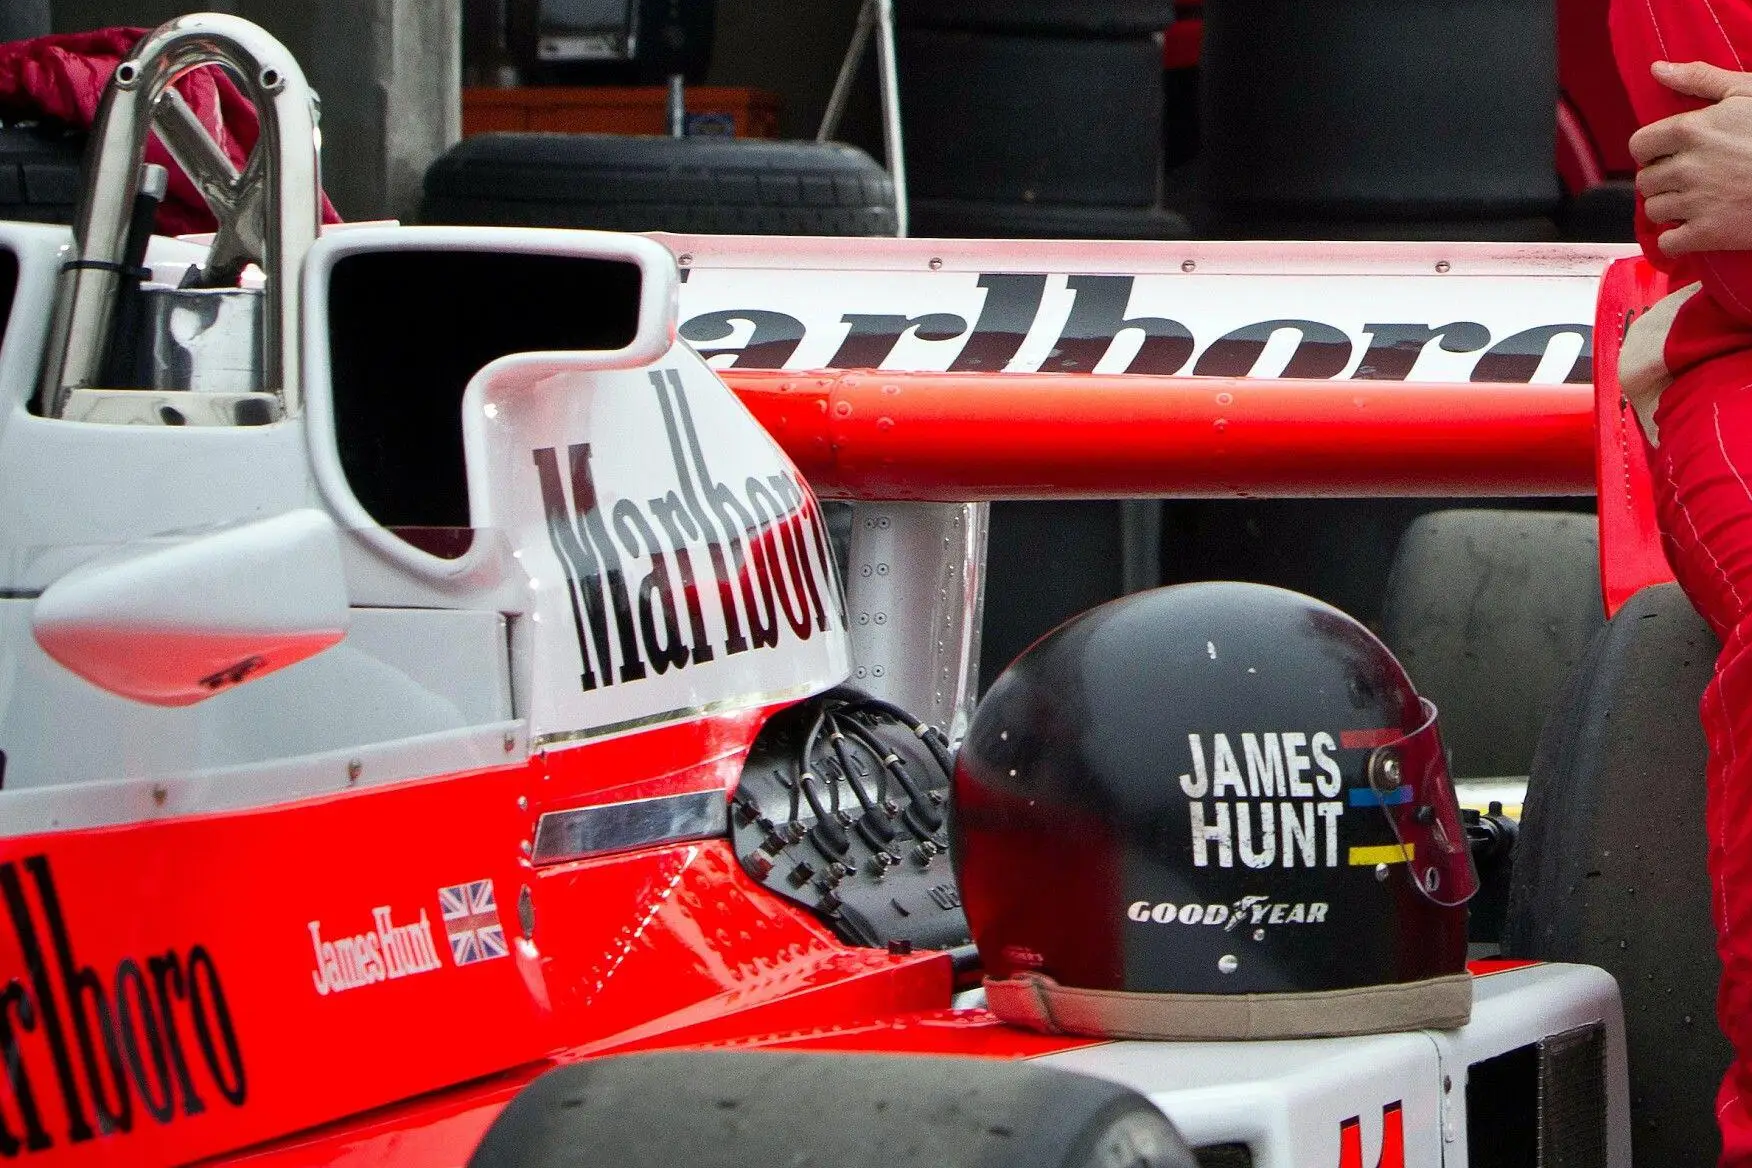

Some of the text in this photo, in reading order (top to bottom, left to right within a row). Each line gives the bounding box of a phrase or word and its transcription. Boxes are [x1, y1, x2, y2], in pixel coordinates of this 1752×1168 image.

[679, 272, 1593, 383] arlboro
[533, 369, 848, 692] Marlbor
[1179, 732, 1341, 798] JAMES
[1188, 801, 1343, 868] HUNT
[1127, 895, 1329, 932] GOODYEAR
[0, 854, 247, 1158] rlboro
